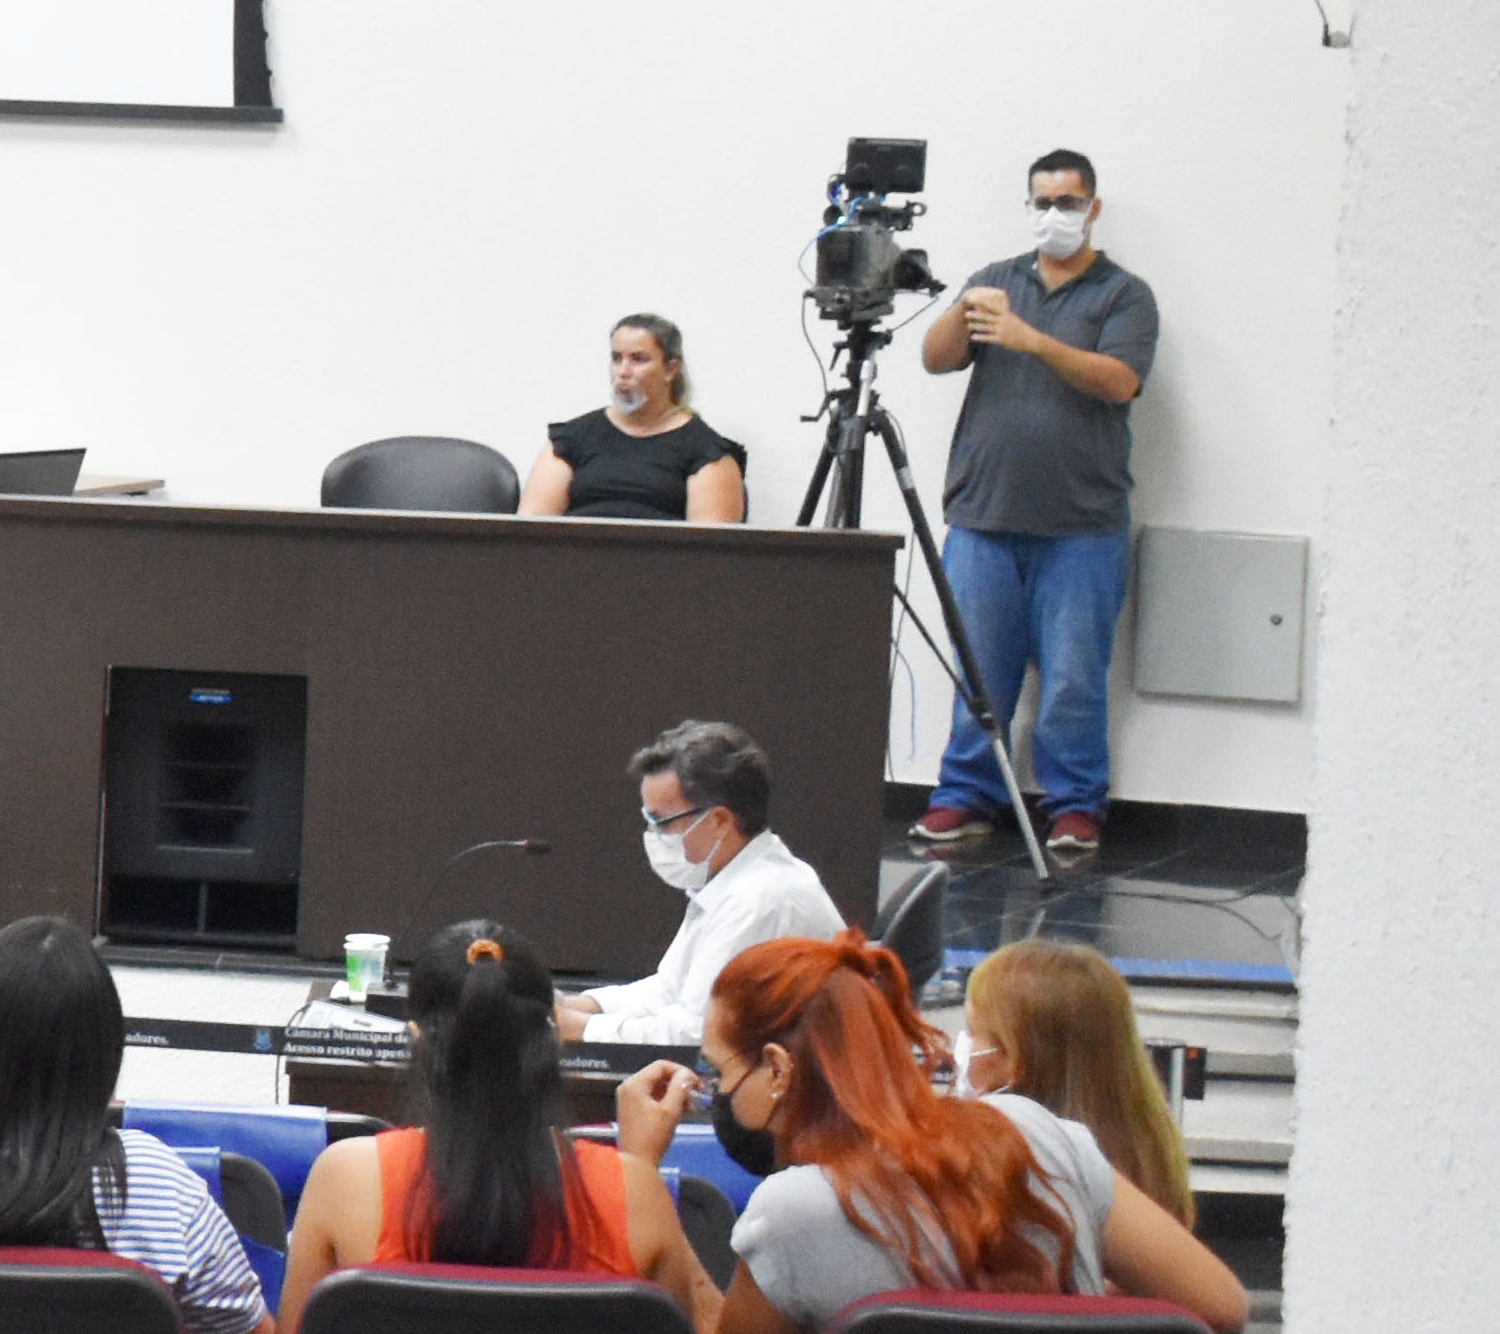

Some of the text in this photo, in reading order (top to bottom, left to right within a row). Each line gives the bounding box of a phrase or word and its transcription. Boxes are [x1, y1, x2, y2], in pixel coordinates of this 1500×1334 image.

[125, 1032, 169, 1046] adores.
[332, 1028, 392, 1044] Municipal
[283, 1042, 325, 1054] Acesso
[326, 1045, 373, 1057] restrito
